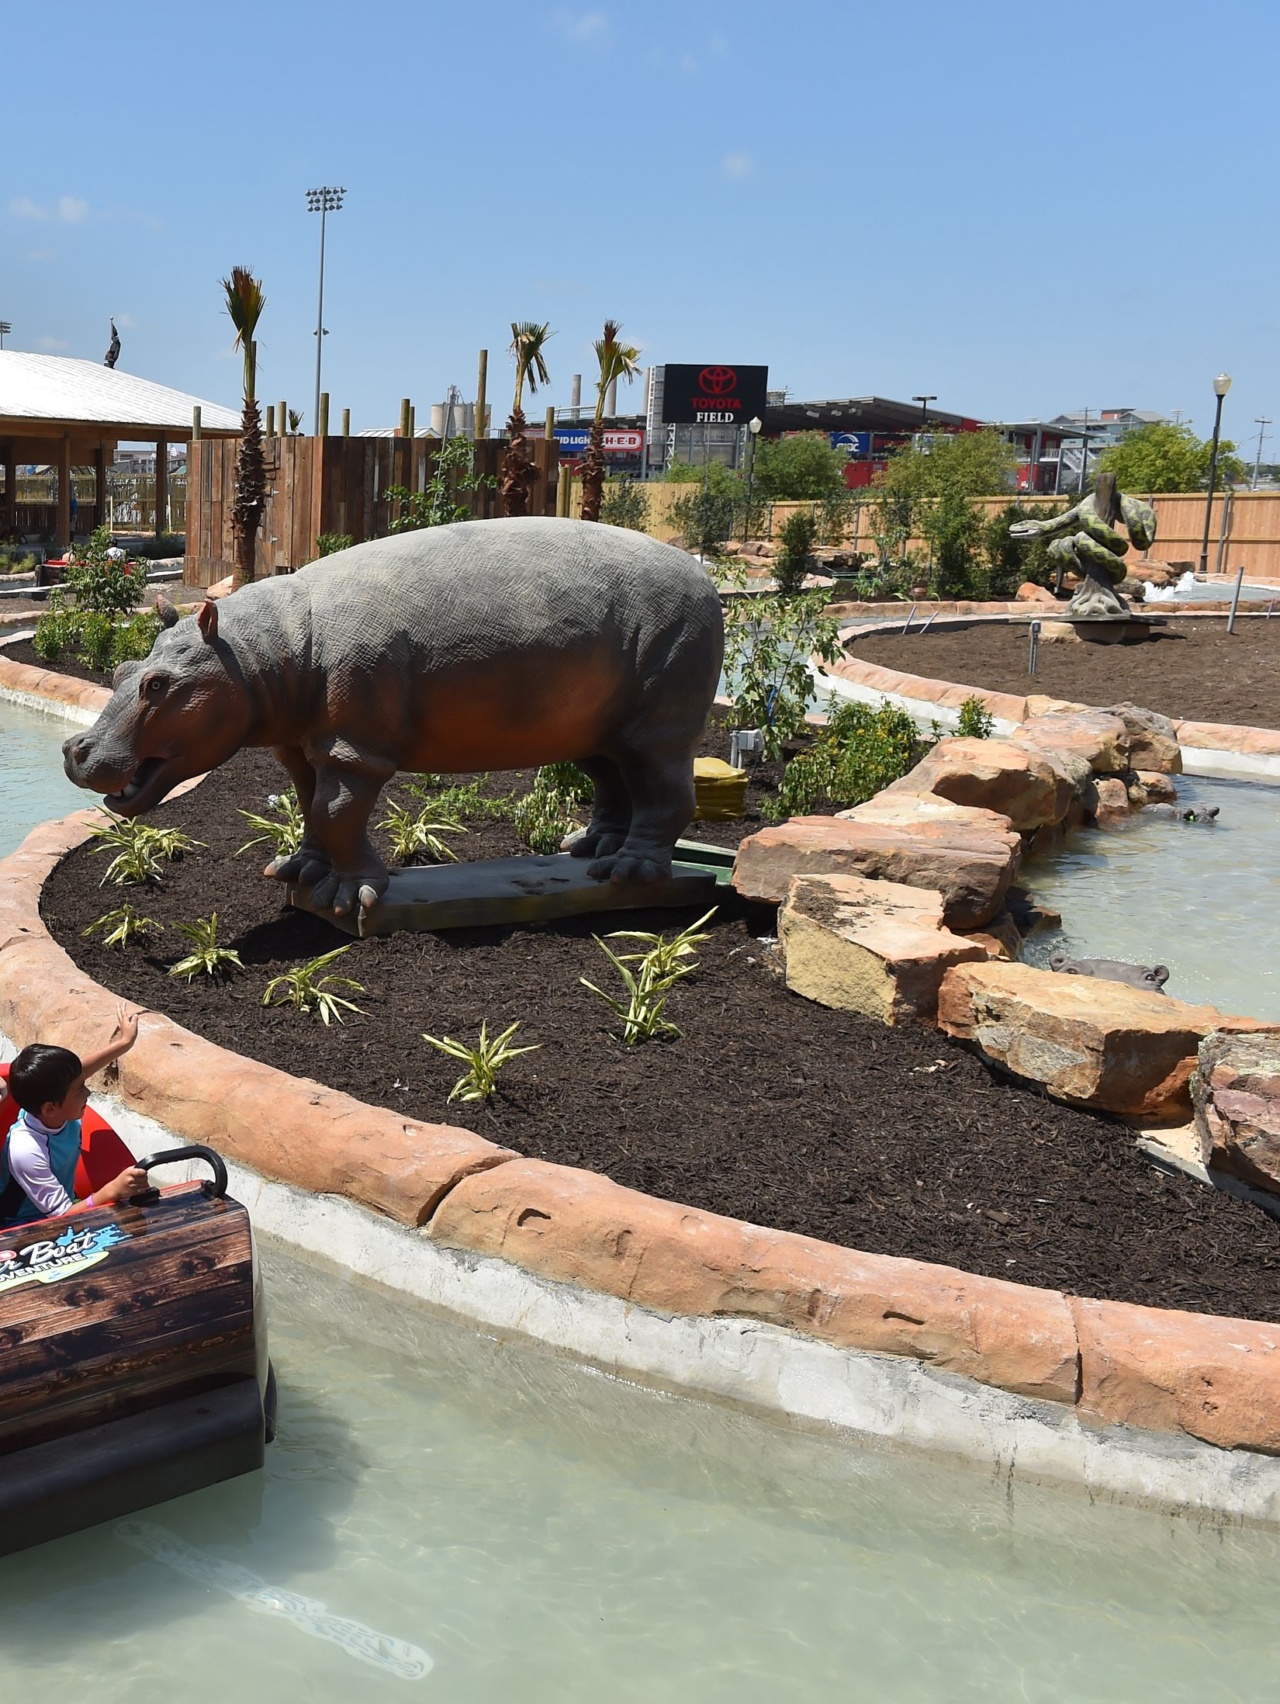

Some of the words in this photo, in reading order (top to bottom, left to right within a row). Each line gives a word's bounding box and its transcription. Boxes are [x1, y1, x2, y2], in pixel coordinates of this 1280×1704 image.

[691, 398, 742, 409] TOYOTA
[696, 411, 734, 423] FIELD
[19, 1231, 98, 1265] Boat
